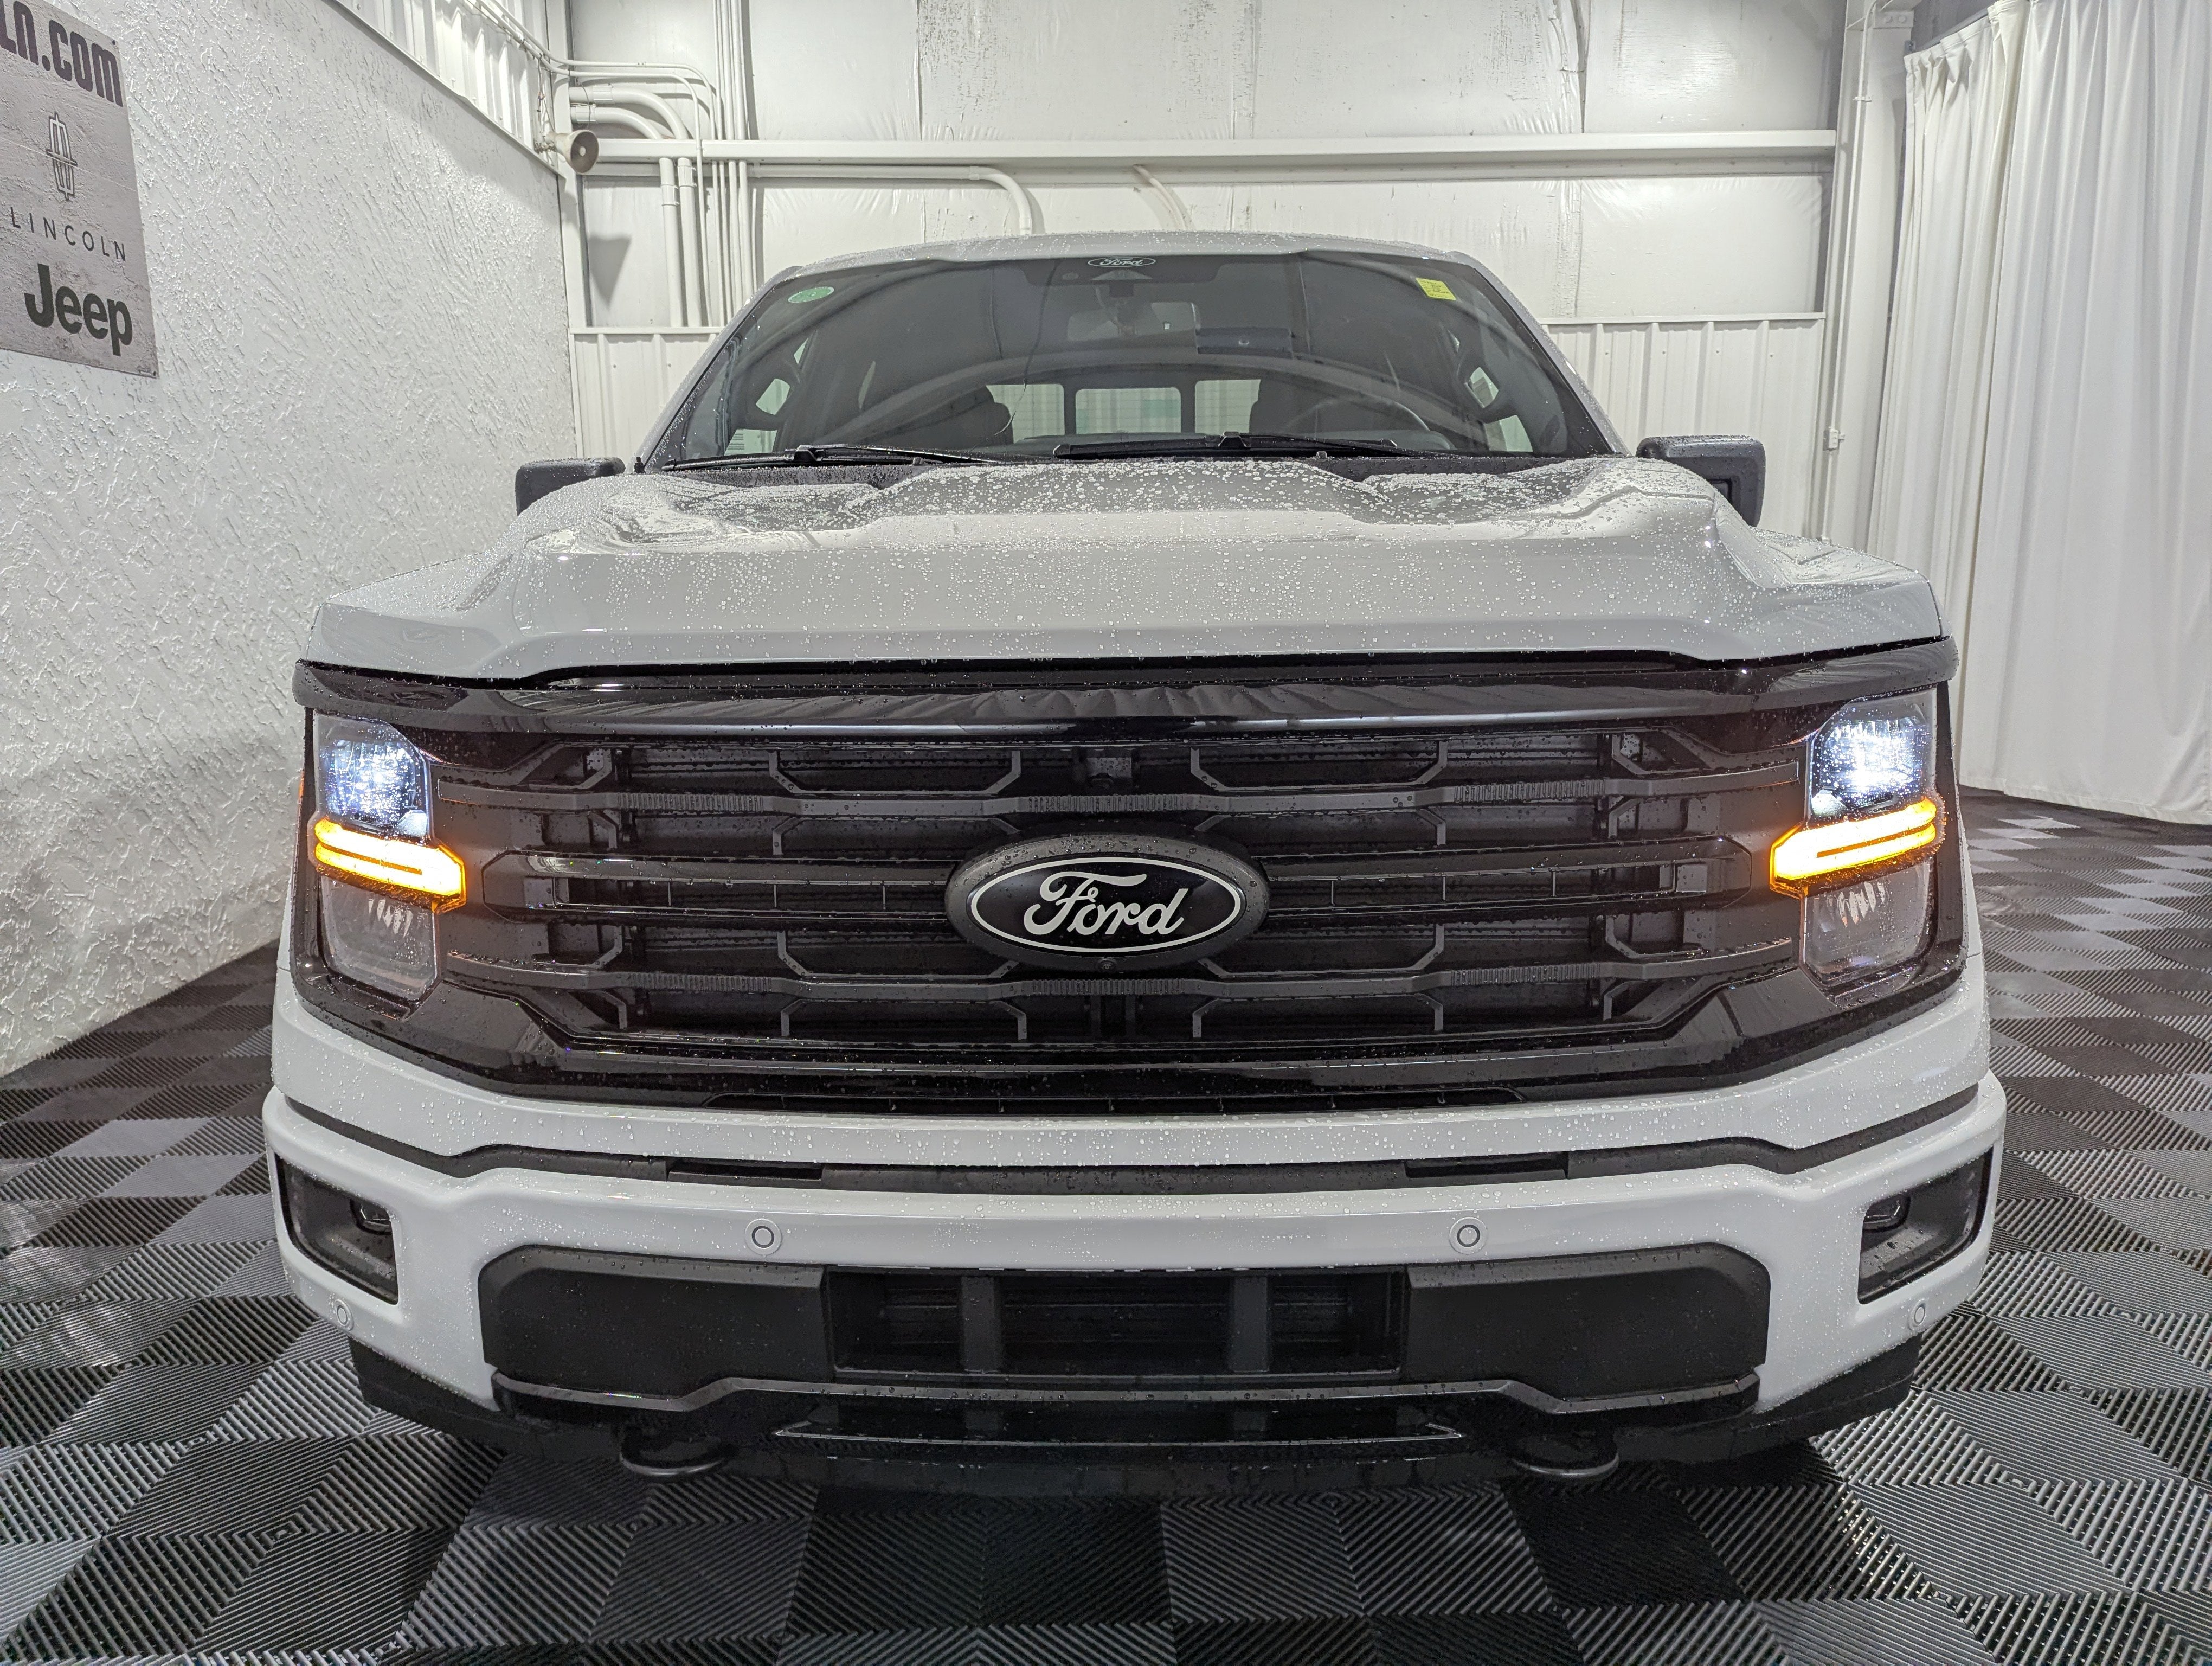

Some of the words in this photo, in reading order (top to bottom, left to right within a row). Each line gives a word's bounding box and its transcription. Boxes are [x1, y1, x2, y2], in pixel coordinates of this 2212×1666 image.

[10, 206, 125, 261] LINCOLN
[24, 263, 132, 356] Jeep
[1024, 871, 1188, 935] Ford
